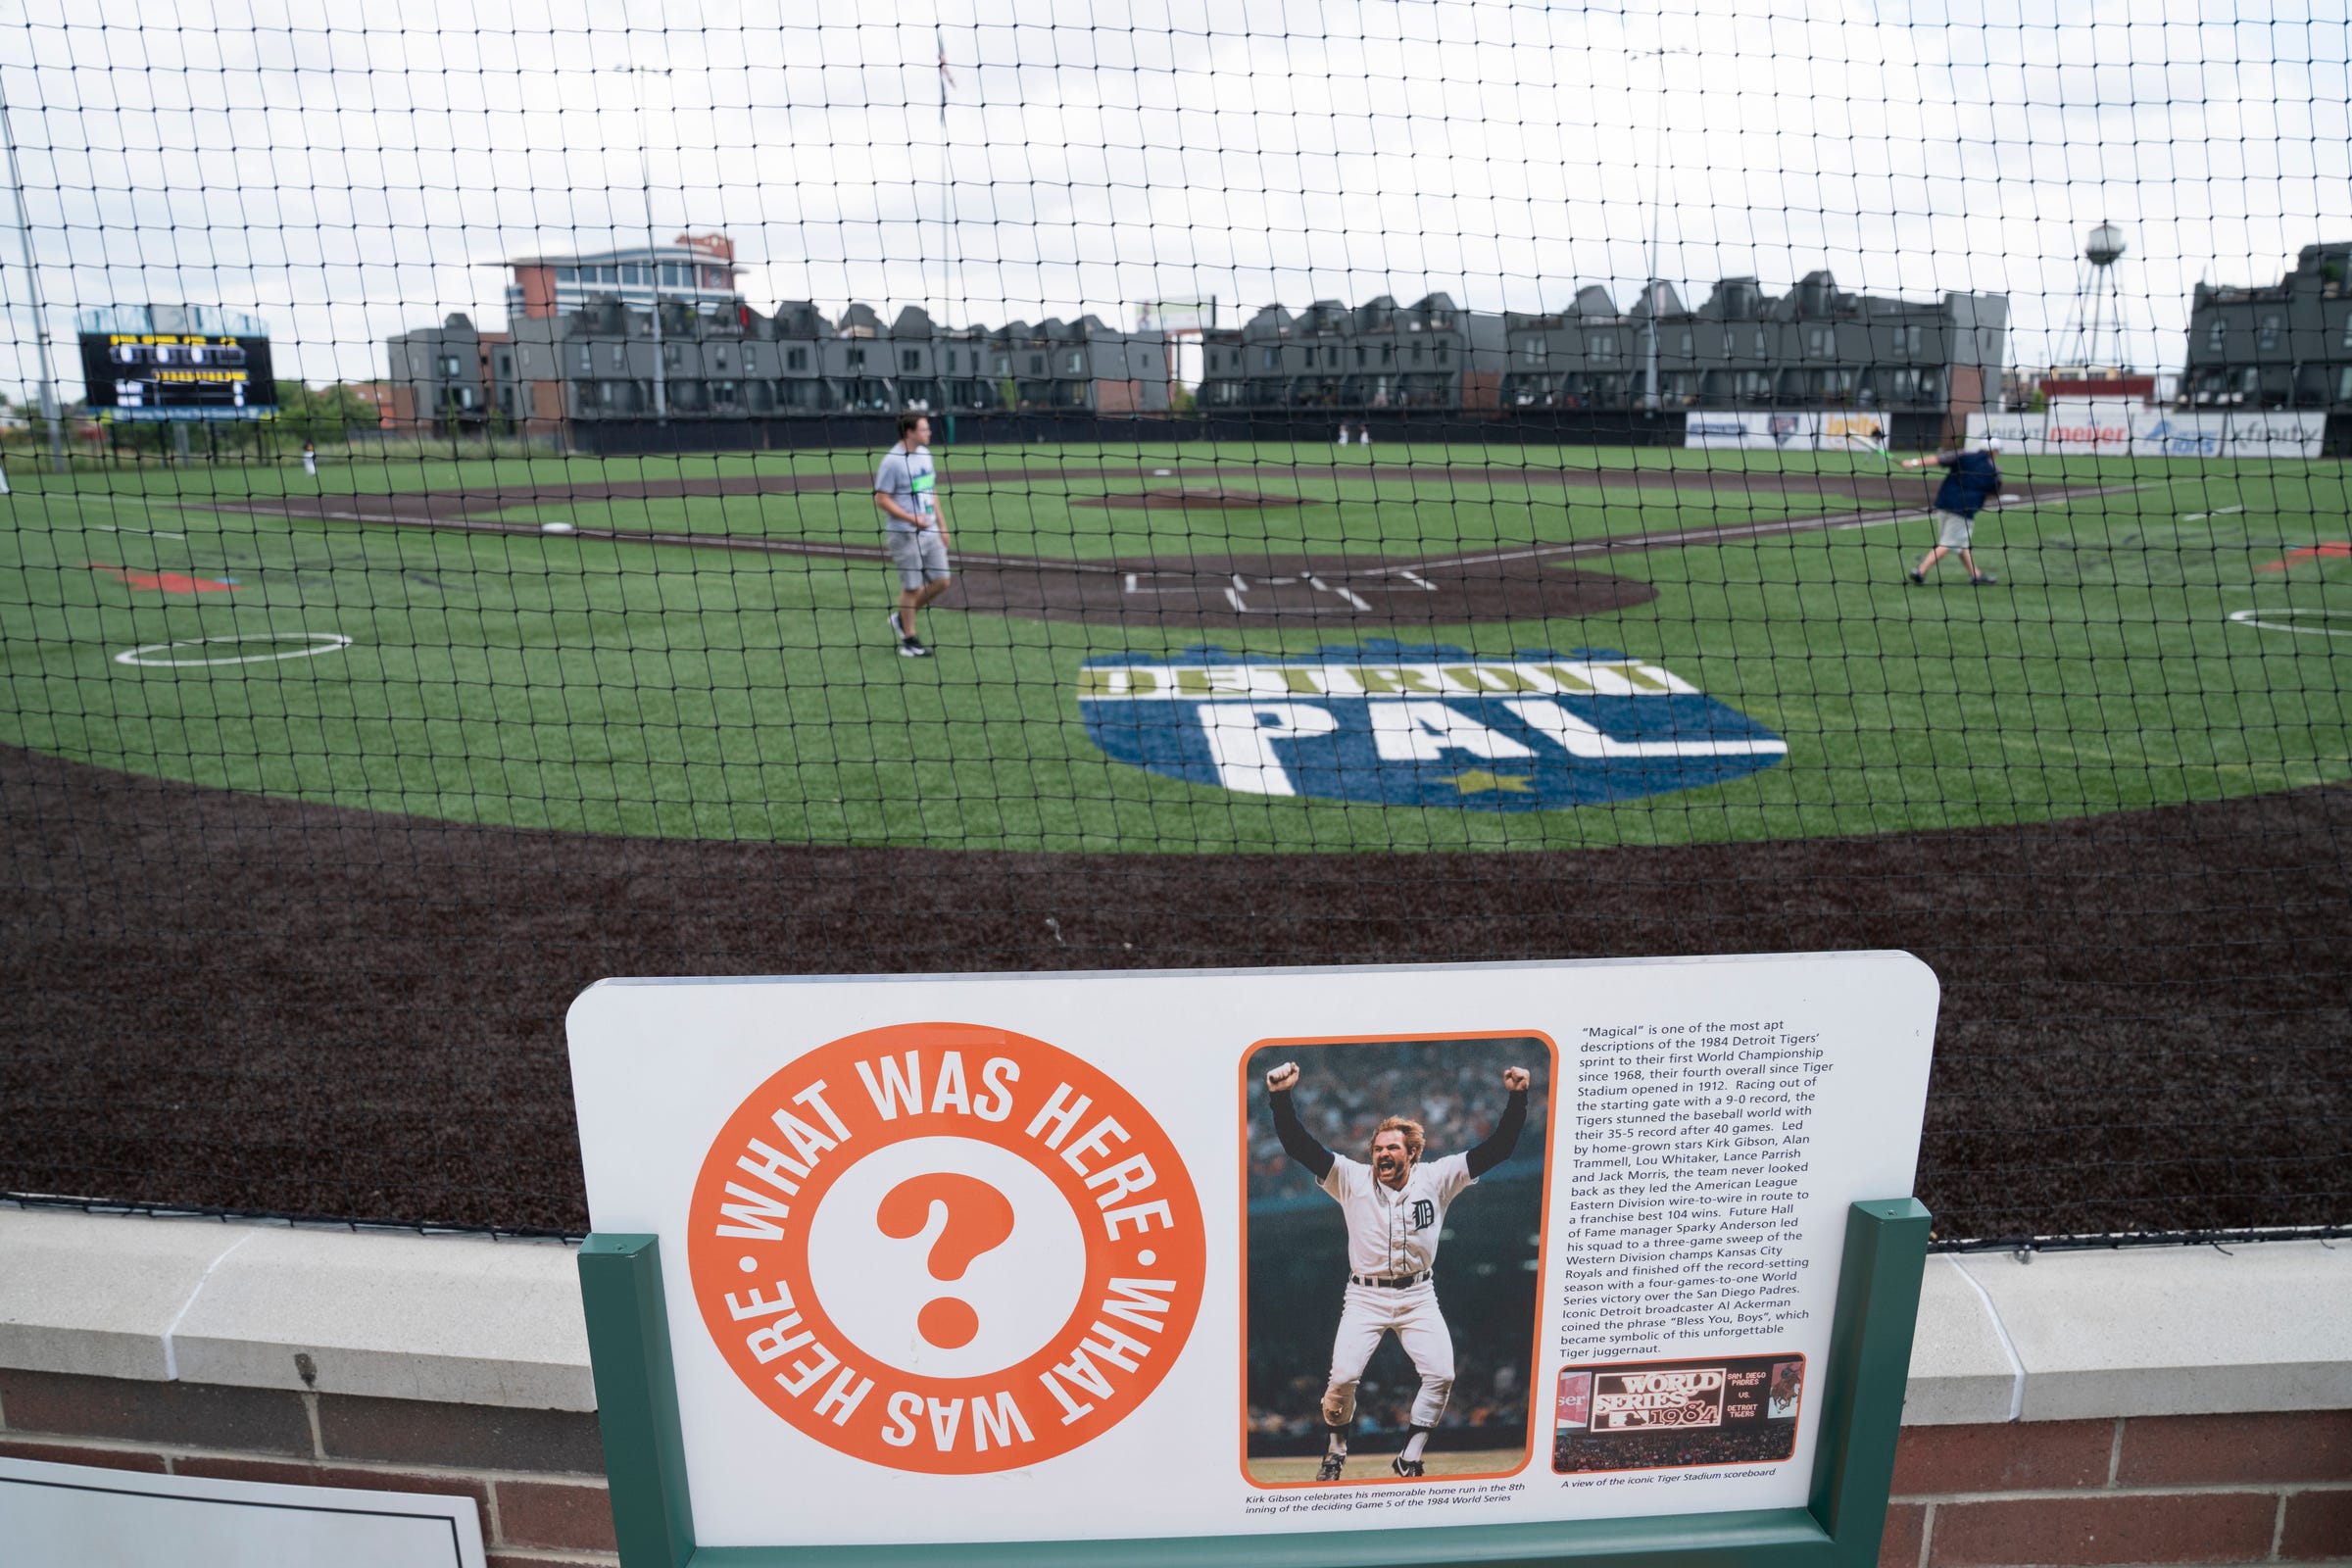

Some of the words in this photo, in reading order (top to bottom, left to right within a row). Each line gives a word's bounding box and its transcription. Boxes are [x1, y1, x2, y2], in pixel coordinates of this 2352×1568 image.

[2050, 420, 2127, 451] meijer
[1078, 667, 1670, 695] DETROIT
[1197, 700, 1788, 797] PAL
[1648, 1024, 1657, 1035] is
[1689, 1022, 1702, 1033] of
[1705, 1022, 1726, 1032] the
[1730, 1021, 1760, 1032] most
[1763, 1020, 1784, 1032] apt
[1581, 1040, 1654, 1054] descriptions
[1658, 1038, 1672, 1050] of
[1675, 1038, 1695, 1049] the
[1701, 1037, 1729, 1048] 1984
[1733, 1035, 1776, 1047] Detroit
[1579, 1072, 1608, 1082] since
[1614, 1070, 1644, 1081] 1968,
[1649, 1068, 1679, 1079] their
[1683, 1066, 1721, 1077] fourth
[1726, 1064, 1766, 1076] overall
[1770, 1063, 1799, 1074] since
[1802, 1062, 1834, 1074] Tiger
[1577, 1101, 1597, 1111] the
[1600, 1100, 1648, 1111] starting
[1652, 1099, 1680, 1110] gate
[1684, 1096, 1711, 1106] with
[1726, 1095, 1746, 1104] 9-0
[1749, 1092, 1790, 1103] record,
[1795, 1092, 1815, 1102] the
[1576, 1115, 1613, 1128] Tigers
[1616, 1112, 1666, 1124] stunned
[1670, 1111, 1690, 1121] the
[1693, 1108, 1742, 1120] baseball
[1746, 1106, 1782, 1118] world
[1786, 1105, 1812, 1116] with
[715, 1079, 852, 1241] WHAT
[855, 1050, 1020, 1122] WAS
[1025, 1081, 1174, 1242] HERE
[1574, 1145, 1589, 1156] by
[1592, 1143, 1671, 1154] home-grown
[1675, 1141, 1702, 1150] stars
[1706, 1138, 1730, 1148] Kirk
[1735, 1137, 1778, 1147] Gibson,
[1783, 1134, 1810, 1145] Alan
[1573, 1156, 1631, 1168] Trammell,
[1636, 1156, 1657, 1165] Lou
[1662, 1153, 1719, 1164] Whitaker,
[1724, 1152, 1757, 1161] Lance
[1761, 1149, 1801, 1159] Parrish
[1571, 1186, 1598, 1197] back
[1619, 1185, 1645, 1196] they
[1649, 1183, 1668, 1193] led
[1671, 1182, 1691, 1192] the
[1694, 1180, 1751, 1191] American
[1755, 1179, 1797, 1189] League
[1411, 1200, 1434, 1232] D
[1581, 1212, 1634, 1224] franchise
[1638, 1211, 1662, 1221] best
[1668, 1209, 1688, 1219] 104
[1691, 1208, 1721, 1218] wins.
[1730, 1207, 1767, 1216] Future
[1771, 1203, 1793, 1214] Hall
[1568, 1228, 1581, 1238] of
[1585, 1228, 1616, 1238] Fame
[1620, 1226, 1673, 1237] manager
[1677, 1222, 1716, 1235] Sparky
[1719, 1220, 1776, 1230] Anderson
[1781, 1217, 1798, 1227] led
[877, 1172, 1015, 1349] ?
[1566, 1256, 1615, 1265] Western
[1620, 1252, 1665, 1262] Division
[1669, 1250, 1713, 1260] champs
[1717, 1249, 1756, 1257] Kansas
[1760, 1246, 1783, 1257] City
[1565, 1268, 1602, 1281] Royals
[1605, 1266, 1629, 1277] and
[1632, 1264, 1679, 1275] finished
[1683, 1262, 1701, 1273] off
[1704, 1262, 1724, 1272] the
[1727, 1257, 1809, 1270] record-setting
[1563, 1296, 1597, 1305] Series
[1601, 1295, 1642, 1304] victory
[1674, 1290, 1693, 1299] the
[1696, 1290, 1717, 1298] San
[1721, 1288, 1755, 1298] Diego
[1759, 1285, 1799, 1295] Padres.
[1563, 1308, 1596, 1318] Iconic
[1599, 1306, 1642, 1317] Detroit
[1645, 1303, 1714, 1314] broadcaster
[1717, 1300, 1730, 1310] Al
[1734, 1299, 1790, 1309] Ackerman
[1561, 1336, 1606, 1345] became
[1609, 1331, 1659, 1345] symbolic
[1663, 1330, 1676, 1340] of
[1679, 1329, 1699, 1339] this
[1703, 1324, 1784, 1338] unforgettable
[724, 1280, 875, 1427] HERE
[1039, 1278, 1177, 1426] WHAT
[1560, 1348, 1590, 1359] Tiger
[1592, 1346, 1660, 1358] juggernaut.
[1622, 1371, 1722, 1396] WORLD
[1732, 1378, 1759, 1387] PADRES
[1594, 1392, 1688, 1415] SERIES
[1648, 1399, 1718, 1426] 1984
[882, 1390, 1036, 1452] WAS
[1628, 1476, 1654, 1485] iconic
[1658, 1475, 1681, 1484] Tiger
[1683, 1472, 1721, 1481] Stadium
[1724, 1468, 1776, 1479] scoreboard
[1303, 1493, 1352, 1501] celebrates
[1371, 1489, 1426, 1497] memorable
[1311, 1502, 1352, 1511] deciding
[1452, 1495, 1482, 1504] World
